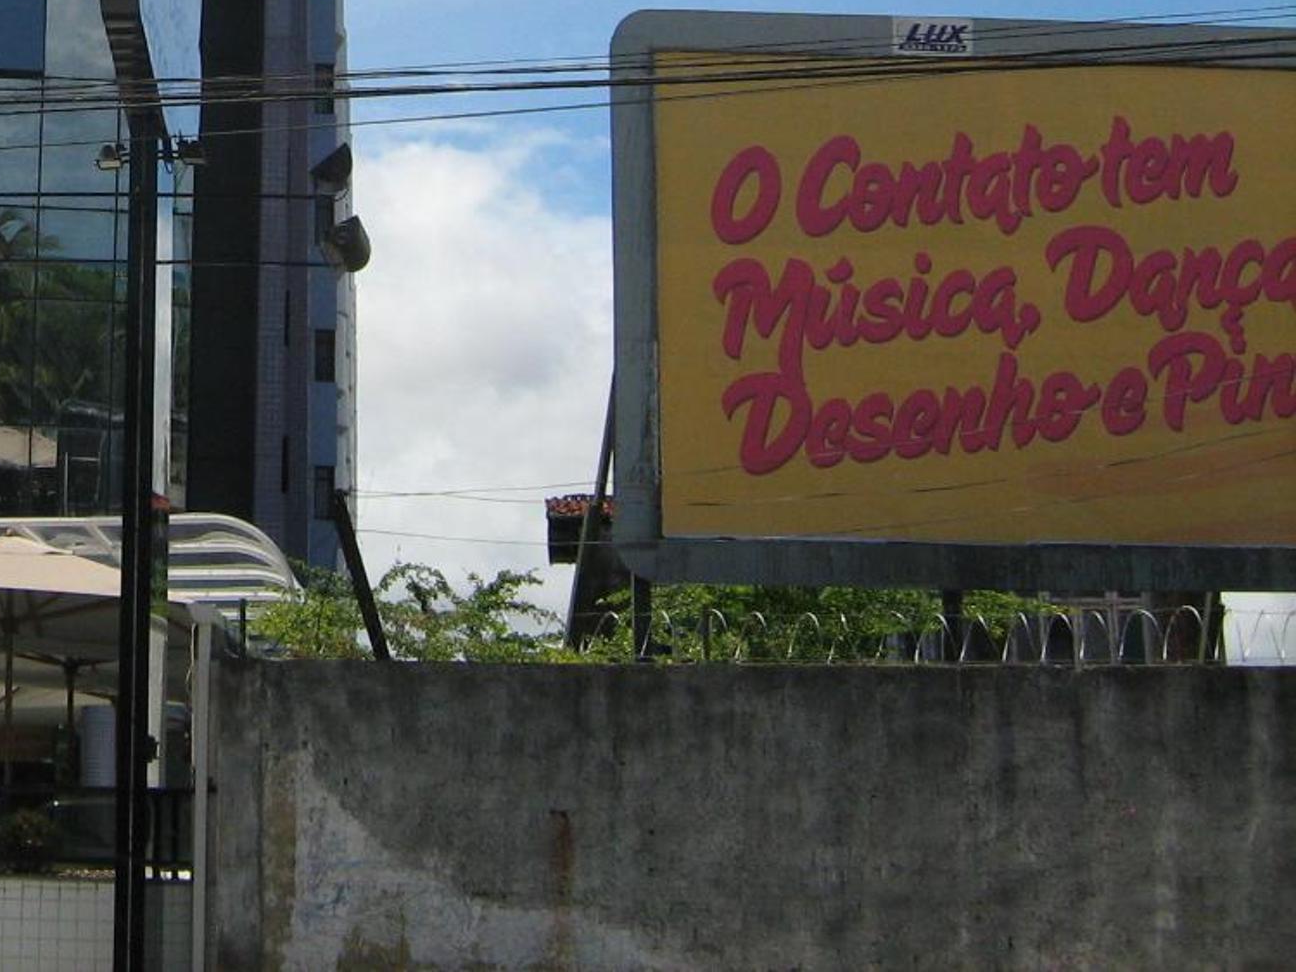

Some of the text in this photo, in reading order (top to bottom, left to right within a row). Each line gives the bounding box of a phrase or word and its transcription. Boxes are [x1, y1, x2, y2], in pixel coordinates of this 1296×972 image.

[906, 23, 969, 43] LUX
[712, 115, 1238, 244] O Contato tem
[713, 252, 1041, 374] Música,
[721, 352, 1100, 475] Desenho
[1102, 366, 1148, 436] e
